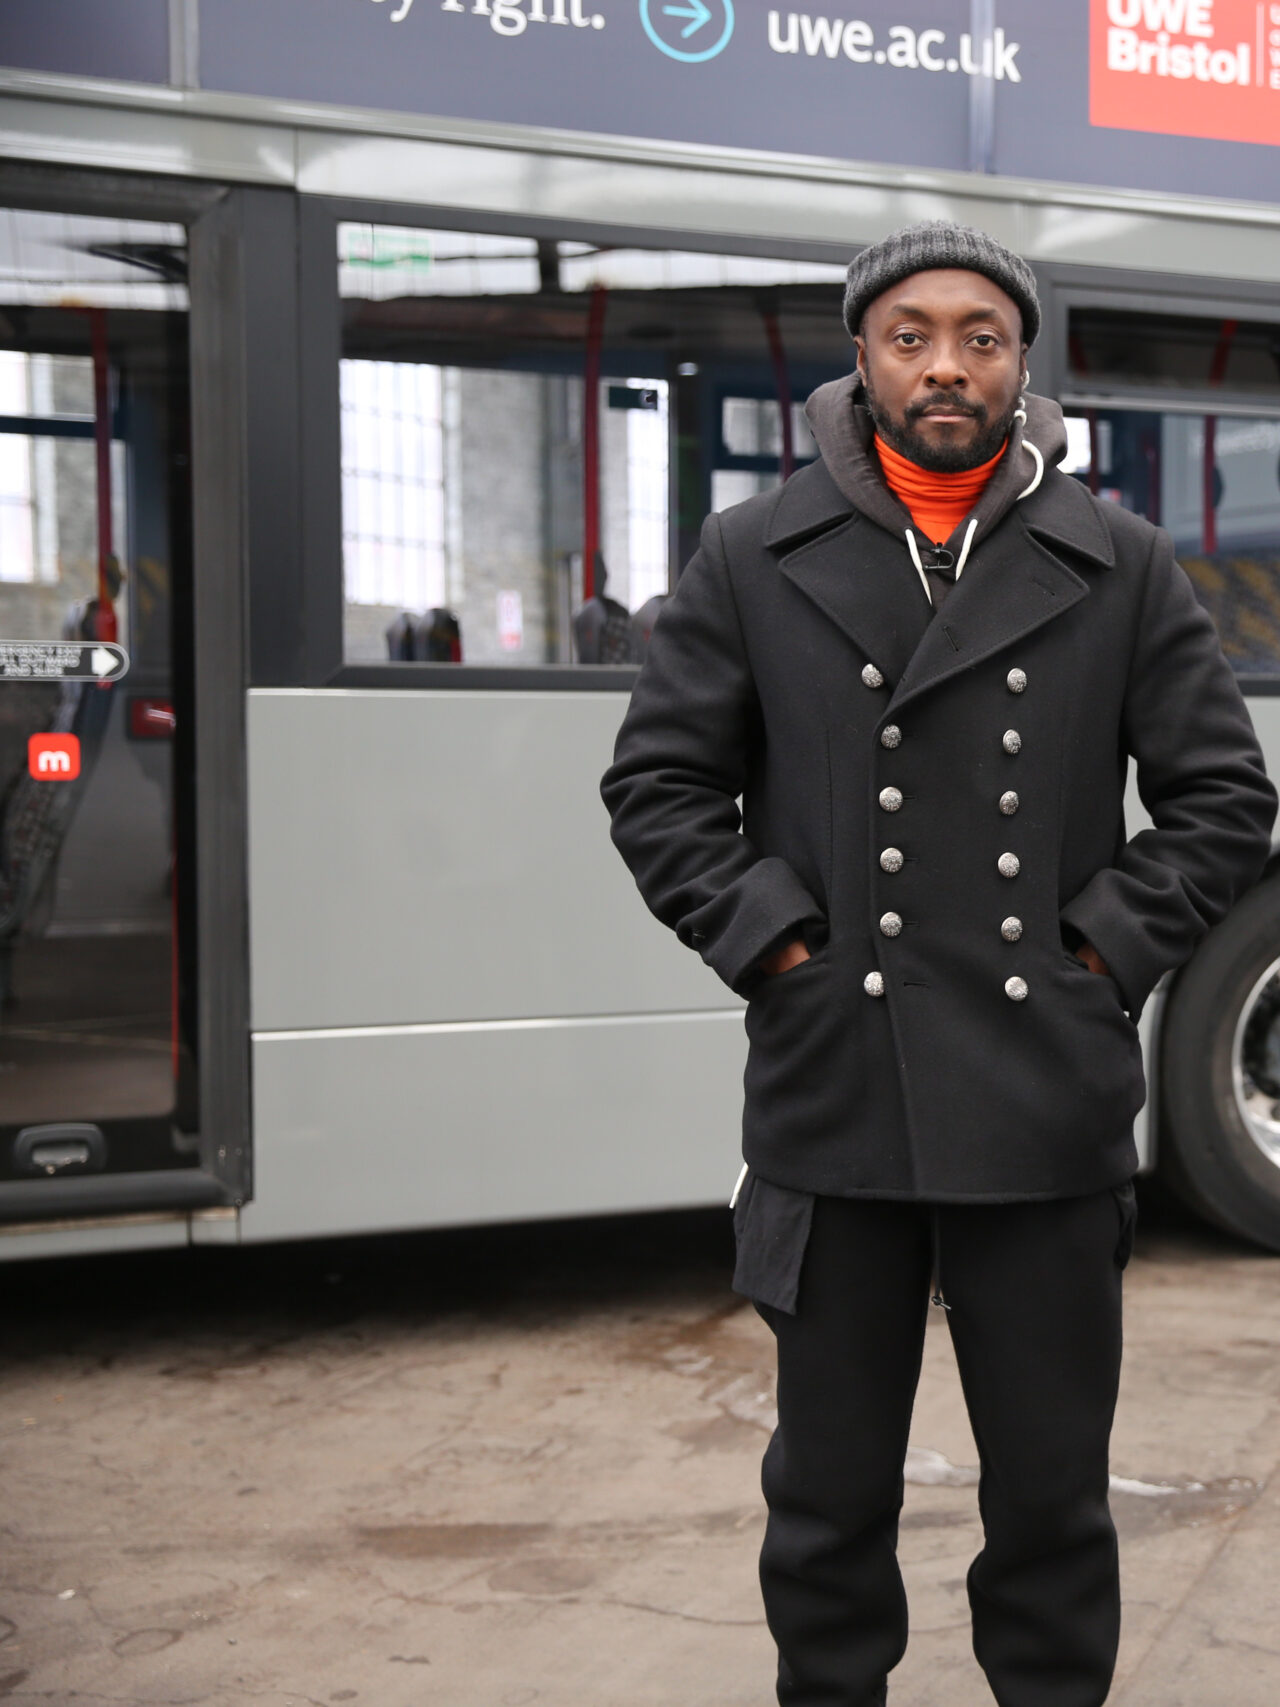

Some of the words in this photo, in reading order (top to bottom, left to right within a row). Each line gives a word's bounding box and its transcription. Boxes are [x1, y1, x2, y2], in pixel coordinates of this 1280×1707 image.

[1107, 0, 1214, 38] UWE
[768, 10, 1021, 83] uwe.ac.uk
[1108, 26, 1250, 86] Bristol
[38, 750, 70, 772] m
